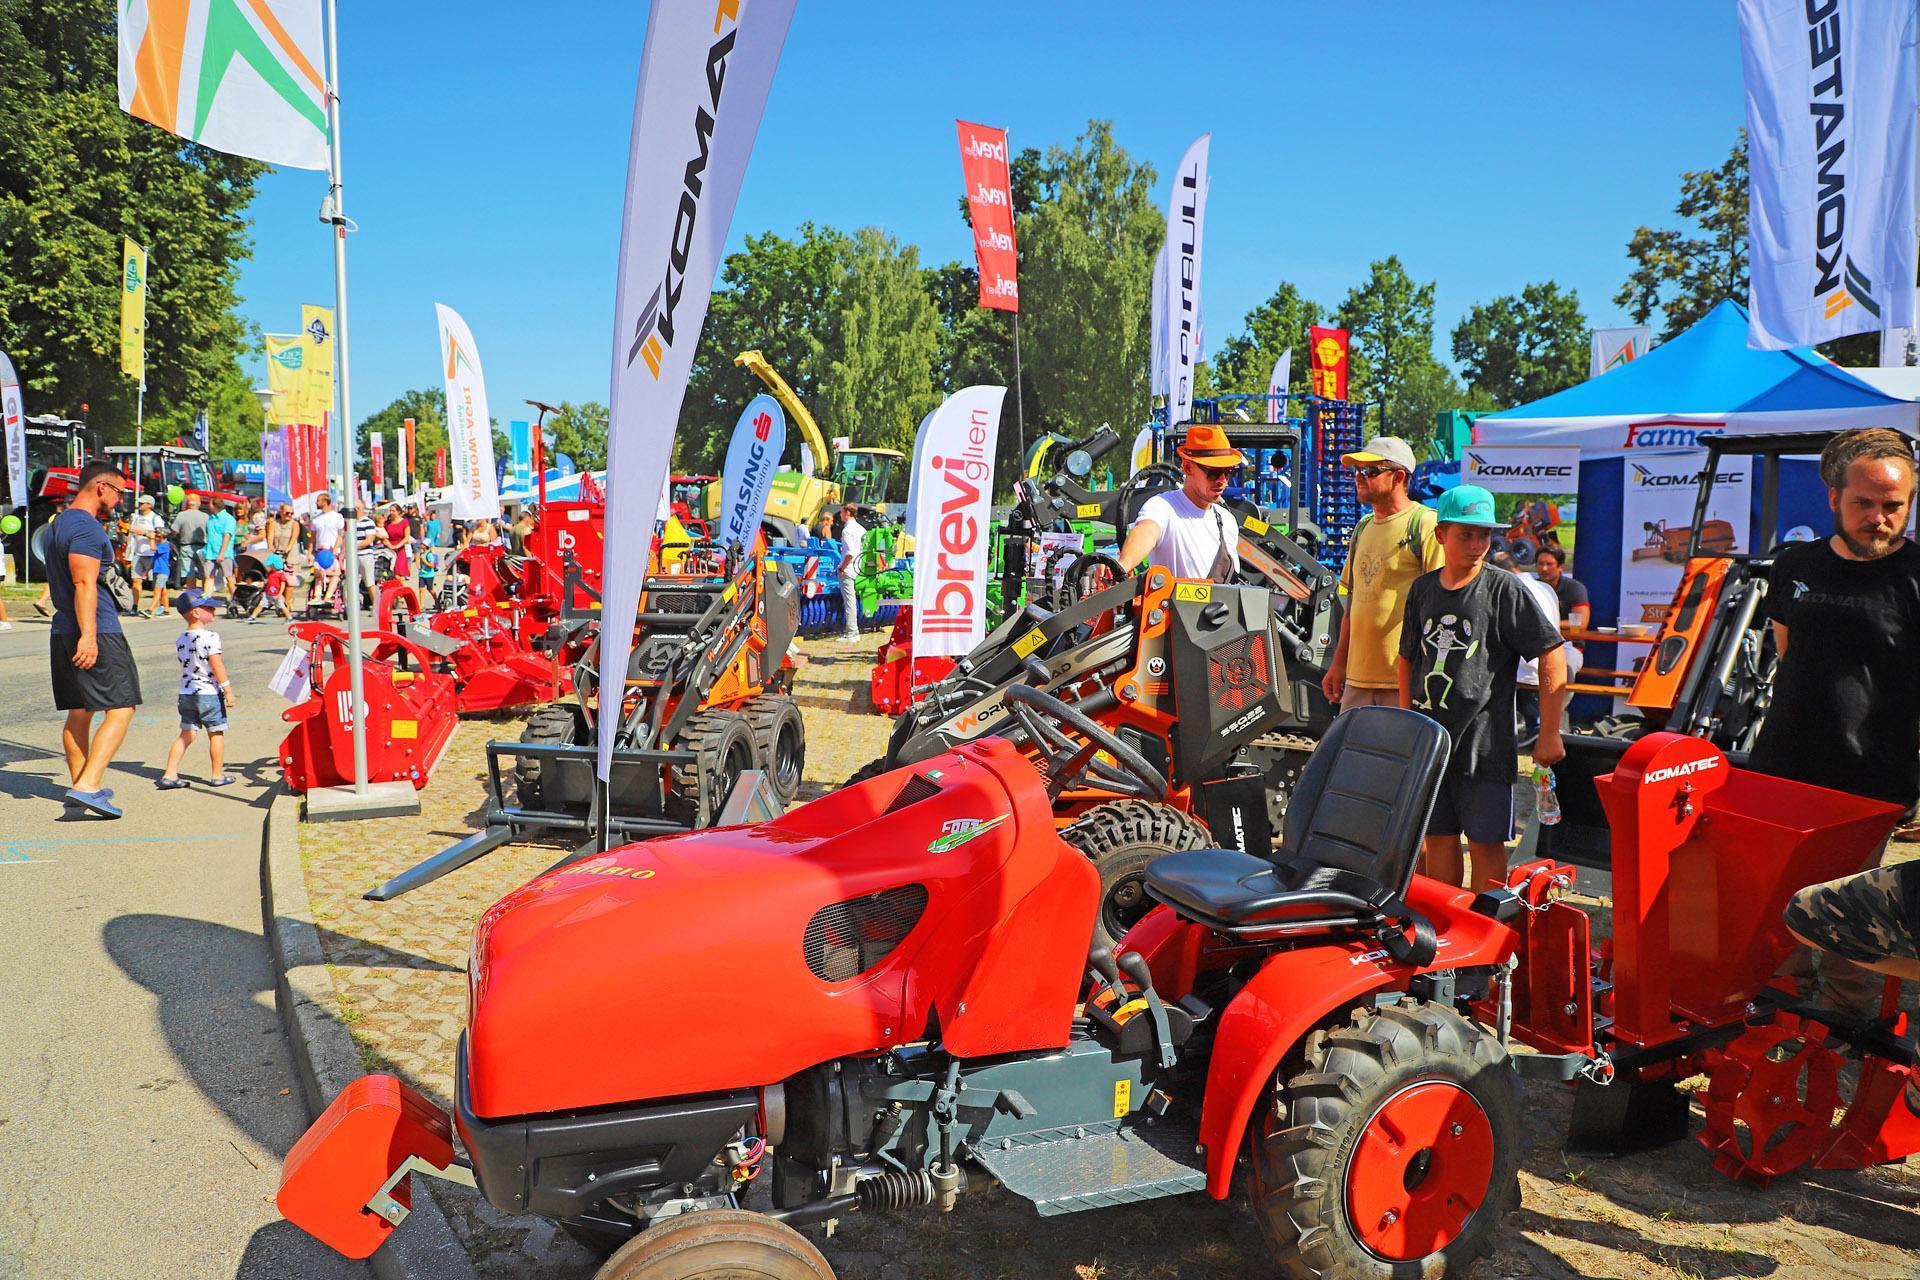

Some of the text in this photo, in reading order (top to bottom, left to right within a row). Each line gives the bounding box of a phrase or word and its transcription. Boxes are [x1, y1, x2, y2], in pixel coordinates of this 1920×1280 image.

[1180, 162, 1198, 367] PITBULL
[1623, 421, 1726, 448] Farm
[1477, 465, 1573, 477] KOMATEC
[1641, 472, 1745, 486] KOMEC
[725, 442, 764, 547] LEASING
[923, 455, 981, 617] brevi
[1644, 755, 1719, 784] KOMATEC
[1232, 806, 1246, 854] MATEC
